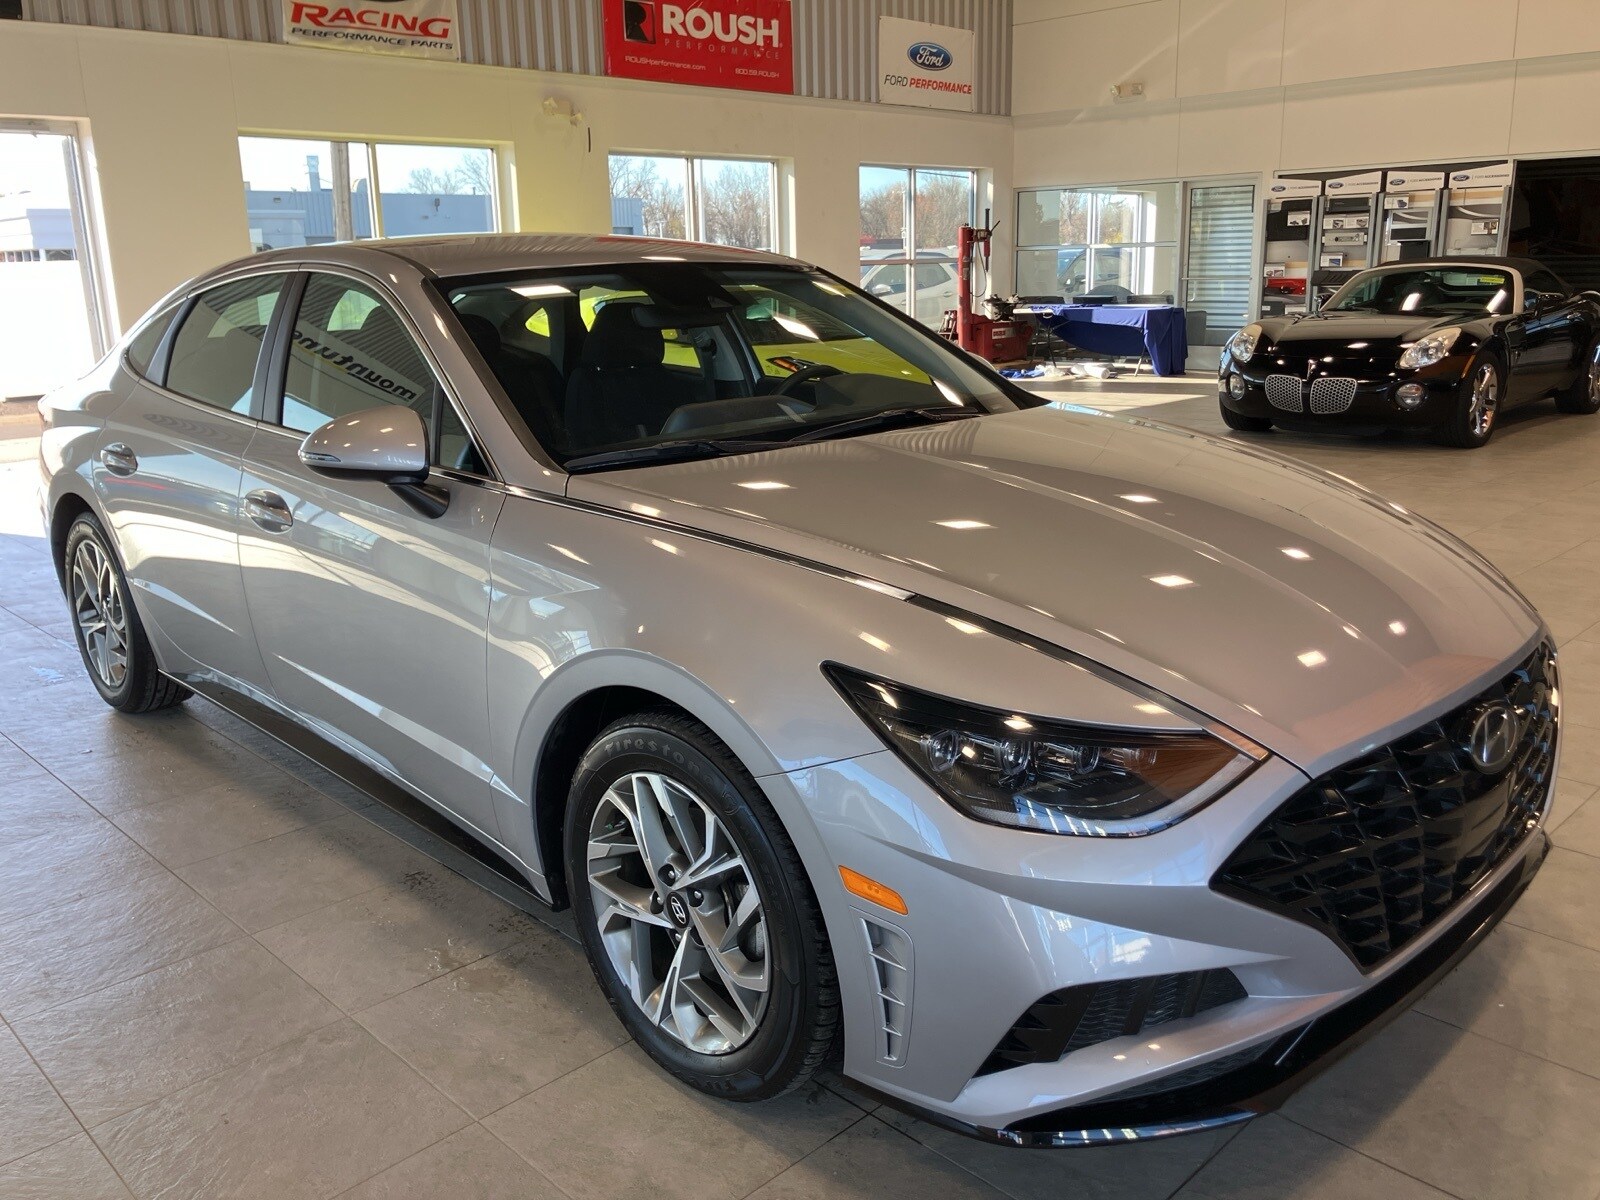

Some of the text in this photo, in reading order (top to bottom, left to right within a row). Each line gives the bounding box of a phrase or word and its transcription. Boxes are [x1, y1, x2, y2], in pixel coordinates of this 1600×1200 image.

[291, 1, 451, 38] RACING
[662, 4, 779, 48] ROUSH
[291, 27, 453, 50] PERFORMANCE PARTS
[664, 38, 779, 60] PERFORMANCE
[625, 55, 706, 71] ROUSHperformance.com
[916, 45, 943, 66] Ford
[884, 74, 972, 94] FORD PERFORMANCE
